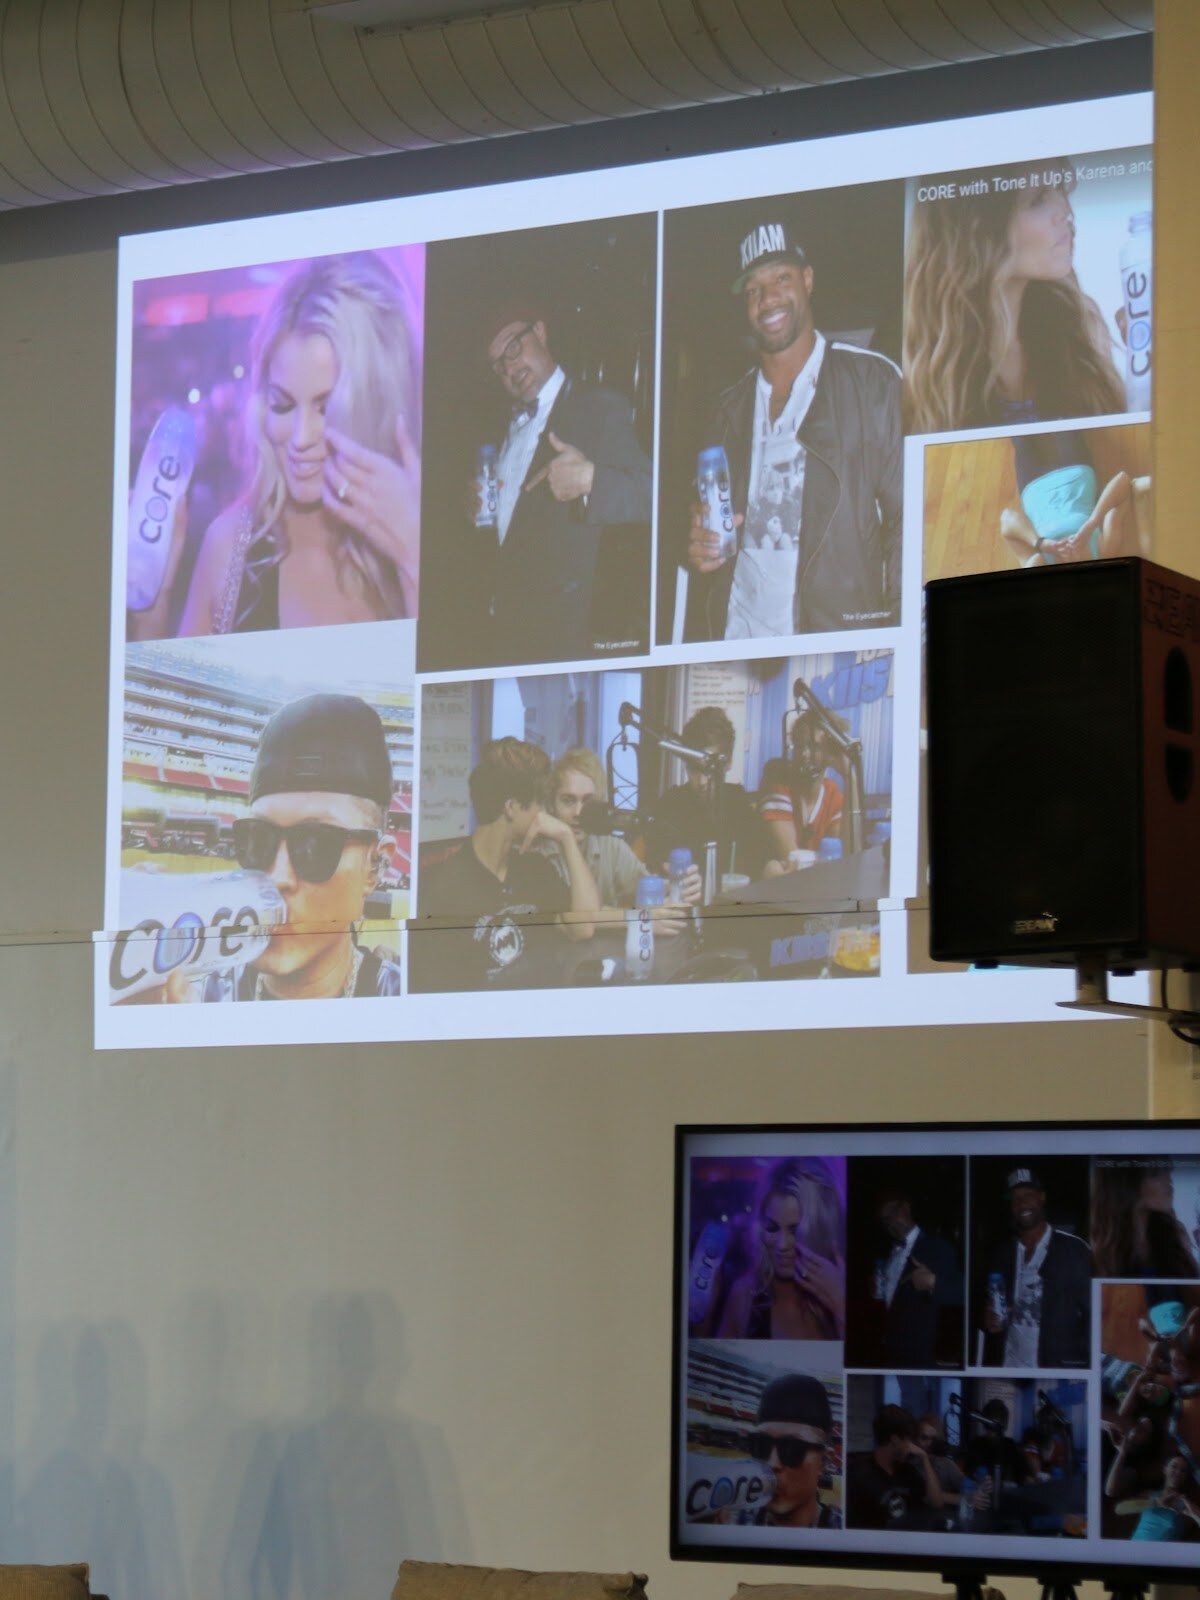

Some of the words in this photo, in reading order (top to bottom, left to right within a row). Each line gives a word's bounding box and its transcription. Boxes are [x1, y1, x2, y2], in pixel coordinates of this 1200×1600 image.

[917, 183, 956, 202] CORE
[959, 177, 989, 197] with
[991, 175, 1026, 193] Tone
[1029, 172, 1040, 187] It
[1043, 168, 1073, 188] Up's
[1075, 162, 1126, 182] Karena
[1126, 271, 1151, 378] core
[139, 454, 181, 544] core
[109, 905, 260, 991] core
